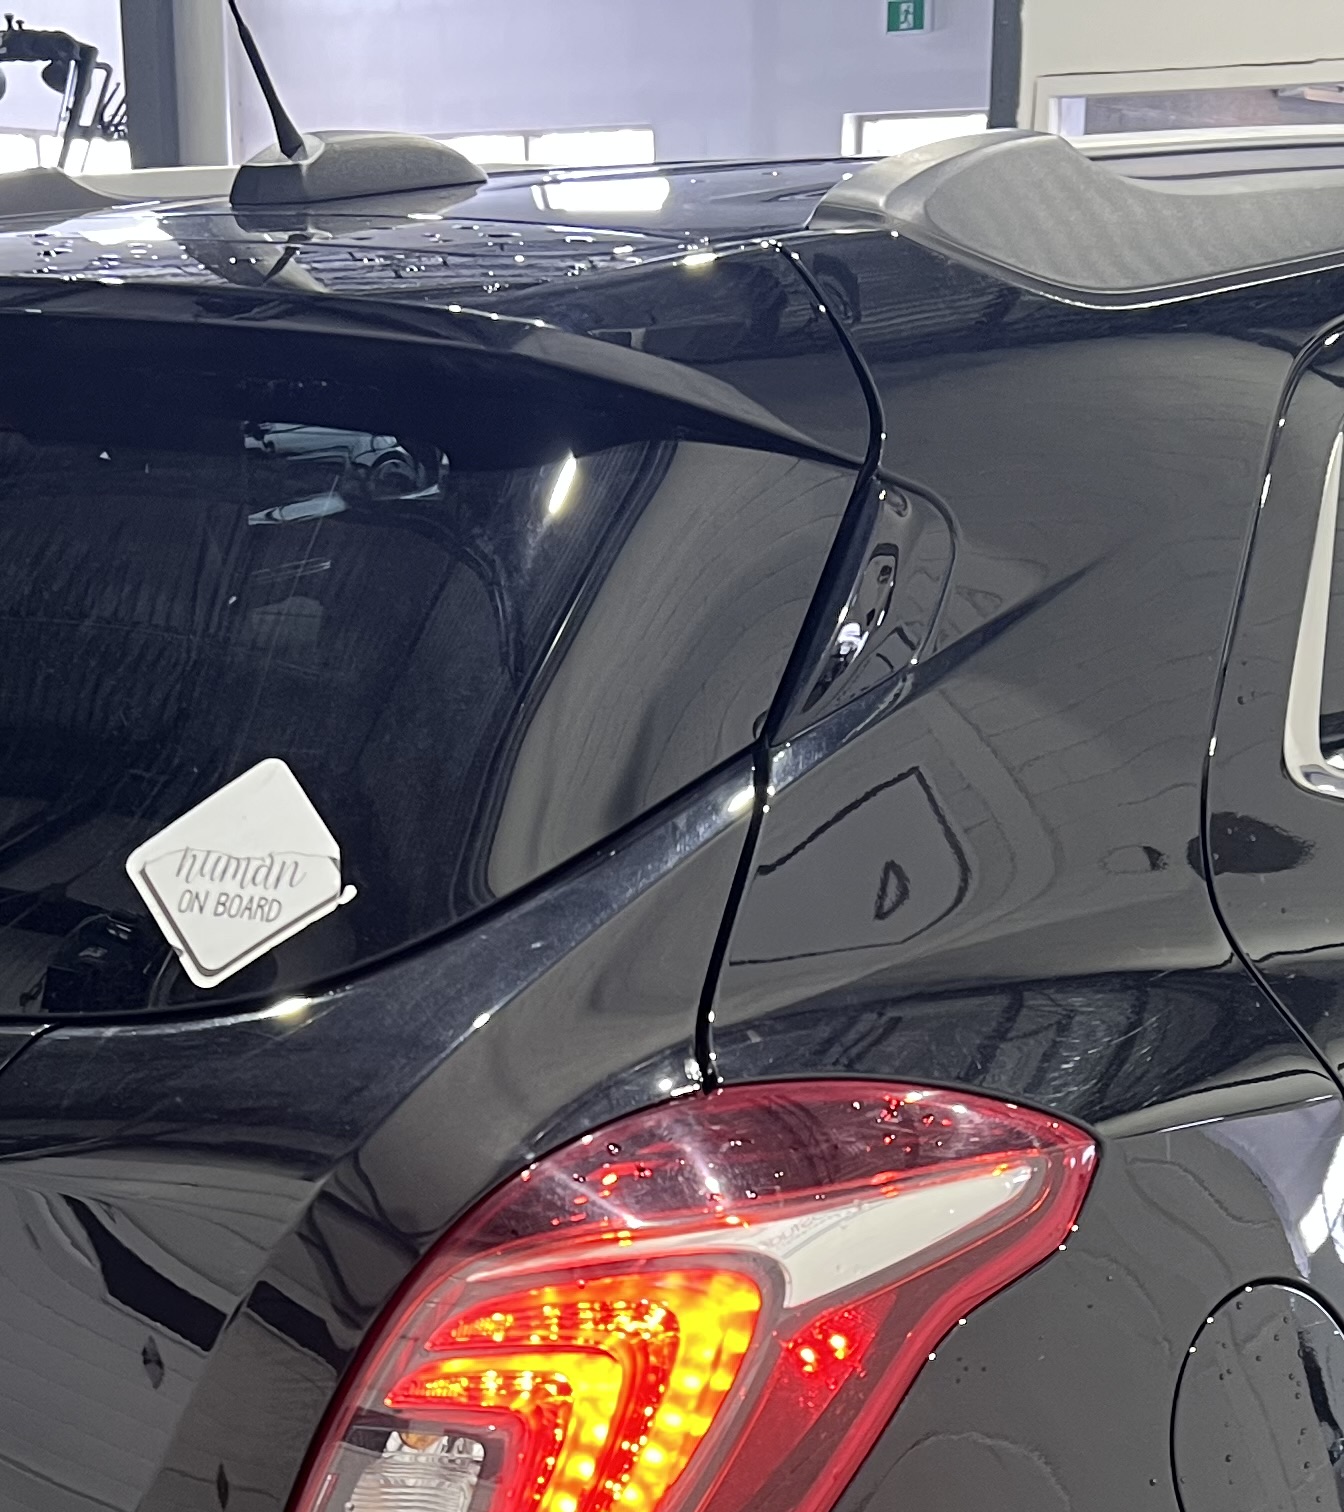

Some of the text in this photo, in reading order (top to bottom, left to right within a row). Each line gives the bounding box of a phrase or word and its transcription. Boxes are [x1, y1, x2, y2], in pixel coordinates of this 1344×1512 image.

[175, 846, 308, 891] human
[177, 889, 283, 923] ON BOARD
